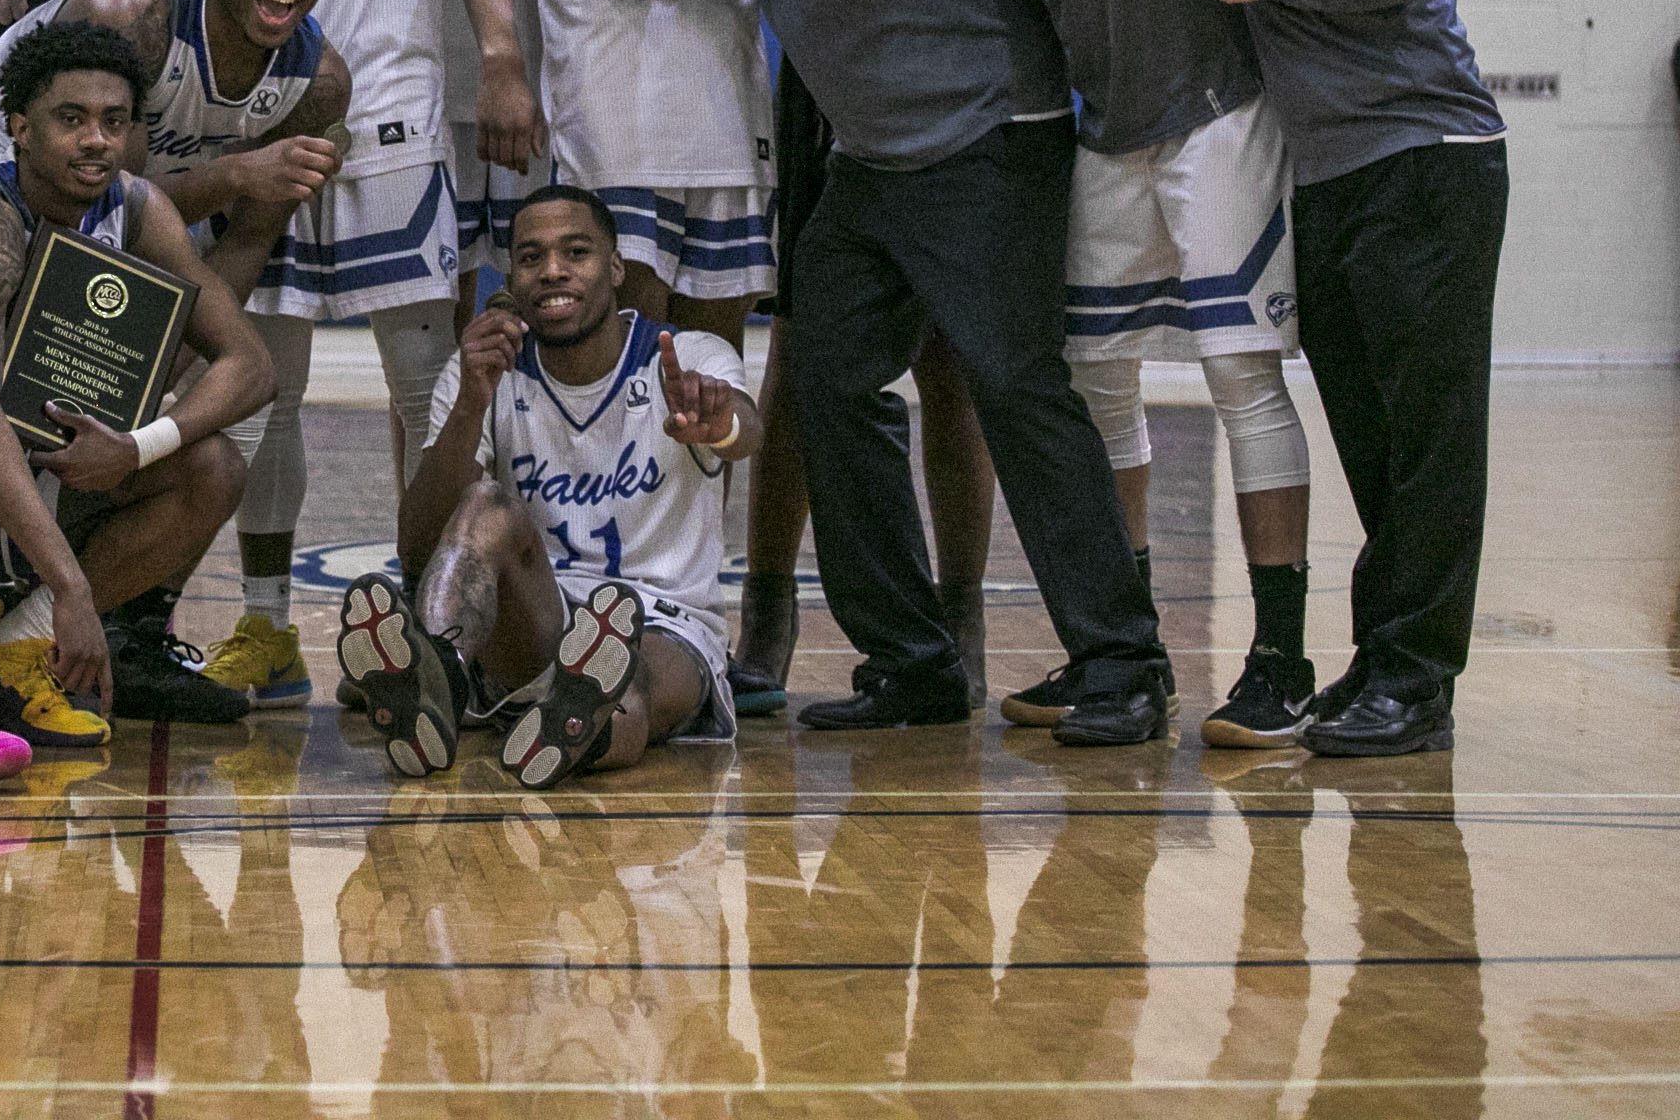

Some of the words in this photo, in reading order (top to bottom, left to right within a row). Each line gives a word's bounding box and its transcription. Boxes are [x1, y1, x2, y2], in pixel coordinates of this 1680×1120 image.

[40, 310, 74, 330] MICHIGAN
[74, 324, 117, 348] COMMUNITY
[116, 344, 145, 362] COLLEGE
[52, 326, 83, 345] ATHLETIC
[84, 340, 127, 364] ASSOCIATION
[83, 318, 109, 335] 2018-19
[34, 353, 71, 375] EASTERN
[71, 370, 124, 399] CONFERENCE
[45, 345, 71, 362] MEN'S
[71, 356, 120, 384] BASKETBALL
[51, 373, 100, 400] CHAMPIONS
[512, 440, 666, 506] Hawks
[546, 516, 622, 577] 11
